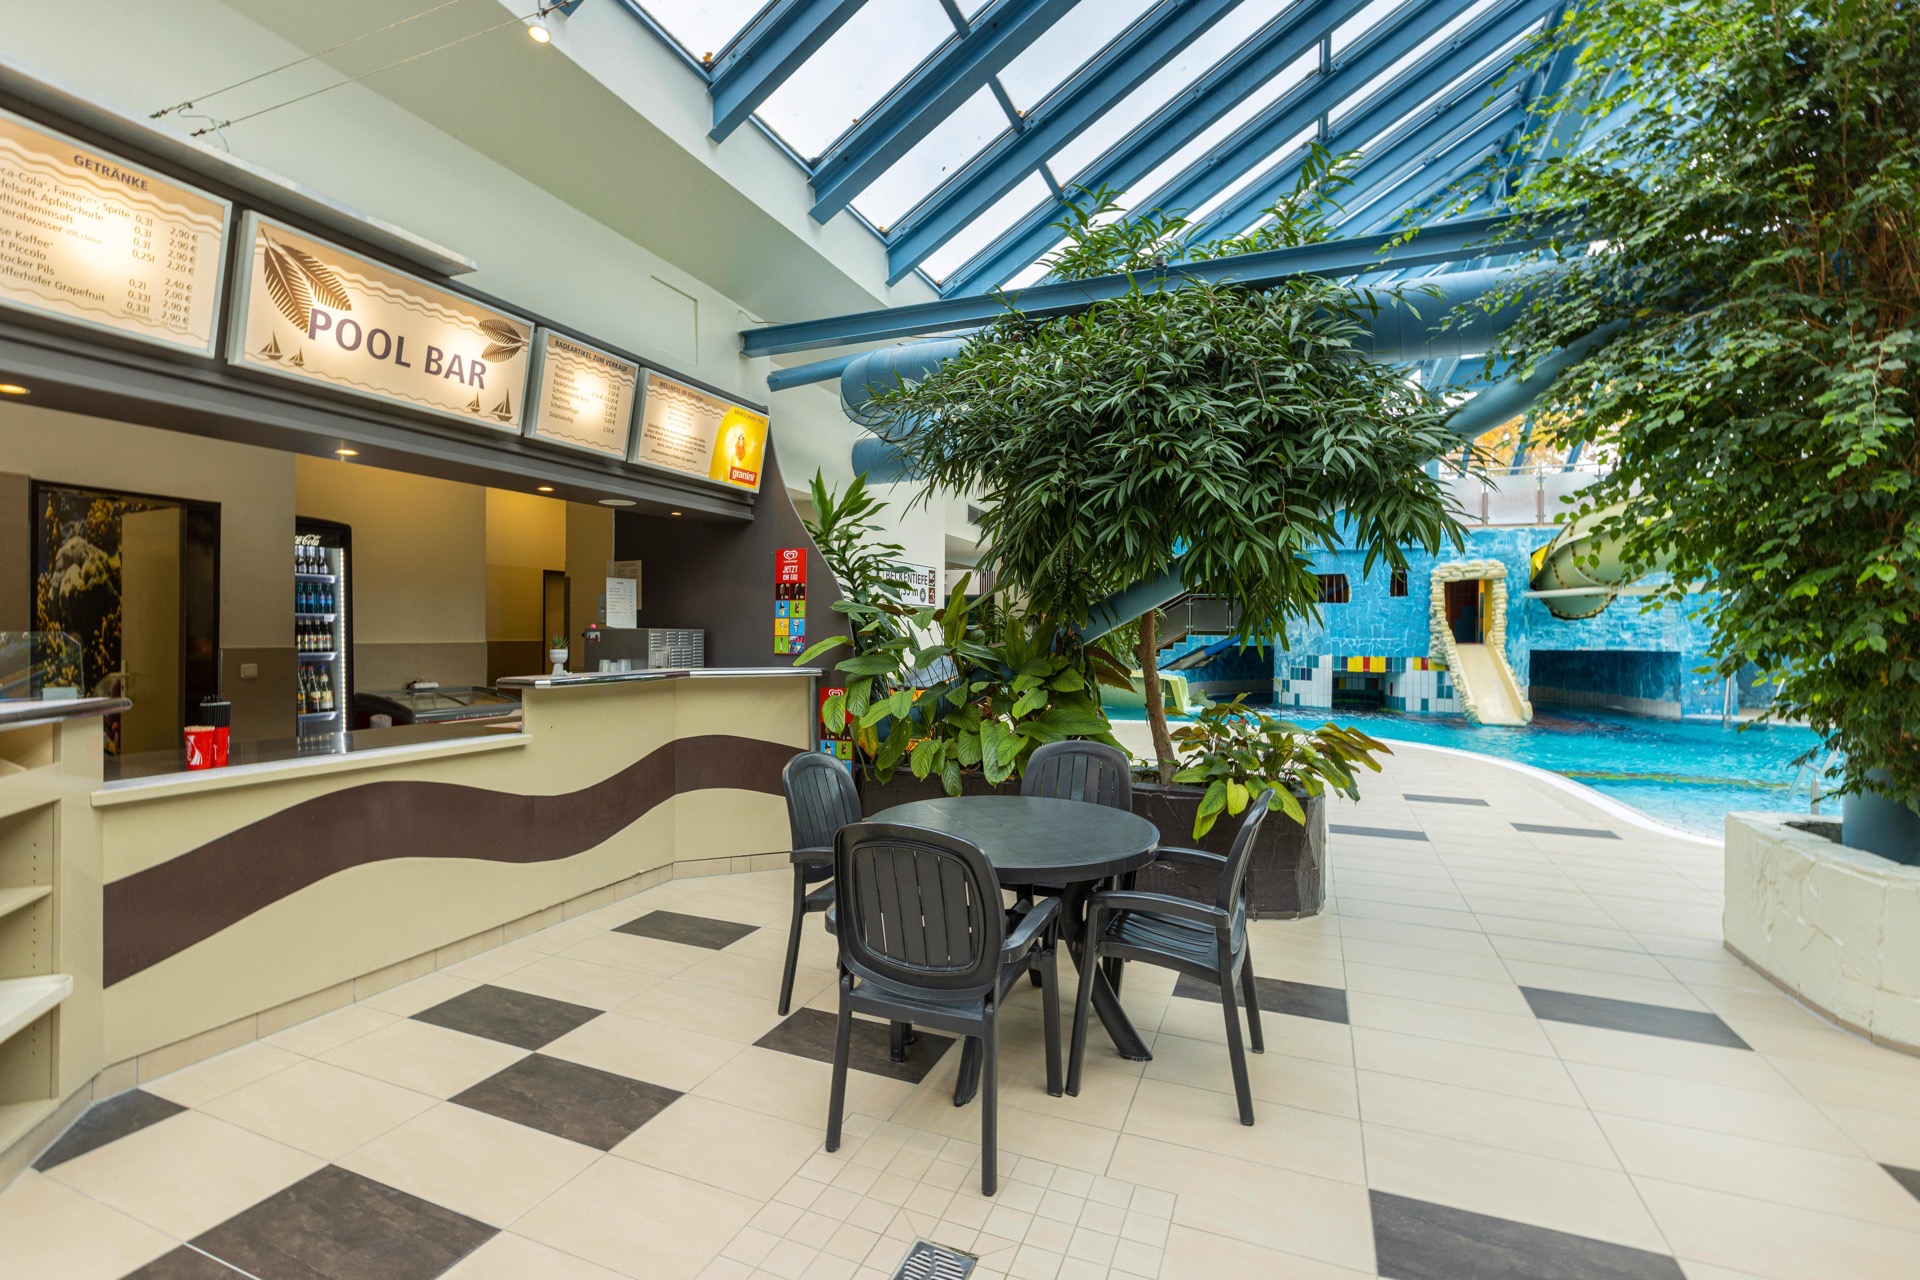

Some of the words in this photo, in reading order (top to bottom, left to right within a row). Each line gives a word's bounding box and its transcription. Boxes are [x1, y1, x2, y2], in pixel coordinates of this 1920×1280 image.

[73, 154, 149, 192] GETRÄNKE
[0, 167, 50, 192] ca-Cola,
[103, 203, 131, 219] Sprite
[170, 227, 190, 240] 2,90
[192, 234, 199, 244] €
[0, 178, 38, 201] felsaft,
[41, 194, 104, 220] Apfelschorle
[169, 238, 189, 251] 2,90
[190, 245, 198, 254] €
[0, 207, 62, 232] neralwasser
[166, 260, 186, 273] 2,20
[188, 267, 195, 276] €
[0, 226, 12, 237] se
[164, 278, 184, 290] 2,40
[186, 284, 193, 293] €
[168, 250, 188, 262] 2,90
[189, 256, 196, 266] €
[0, 252, 33, 270] tocker
[36, 263, 54, 276] Pils
[162, 300, 182, 312] 2,90
[184, 305, 190, 314] €
[8, 241, 47, 260] Piccolo
[164, 288, 184, 301] 7,00
[185, 294, 192, 304] €
[55, 280, 105, 302] Grapefruit
[161, 311, 181, 323] 2,90
[182, 316, 189, 326] €
[308, 308, 412, 369] POOL
[424, 345, 487, 390] BAR
[555, 340, 592, 360] BADEARTIKEL
[592, 354, 604, 364] ZUM
[606, 359, 628, 373] VERKAUF
[660, 381, 681, 394] WELLNESS
[732, 470, 755, 482] granini
[886, 570, 928, 586] BECKENTIEFE
